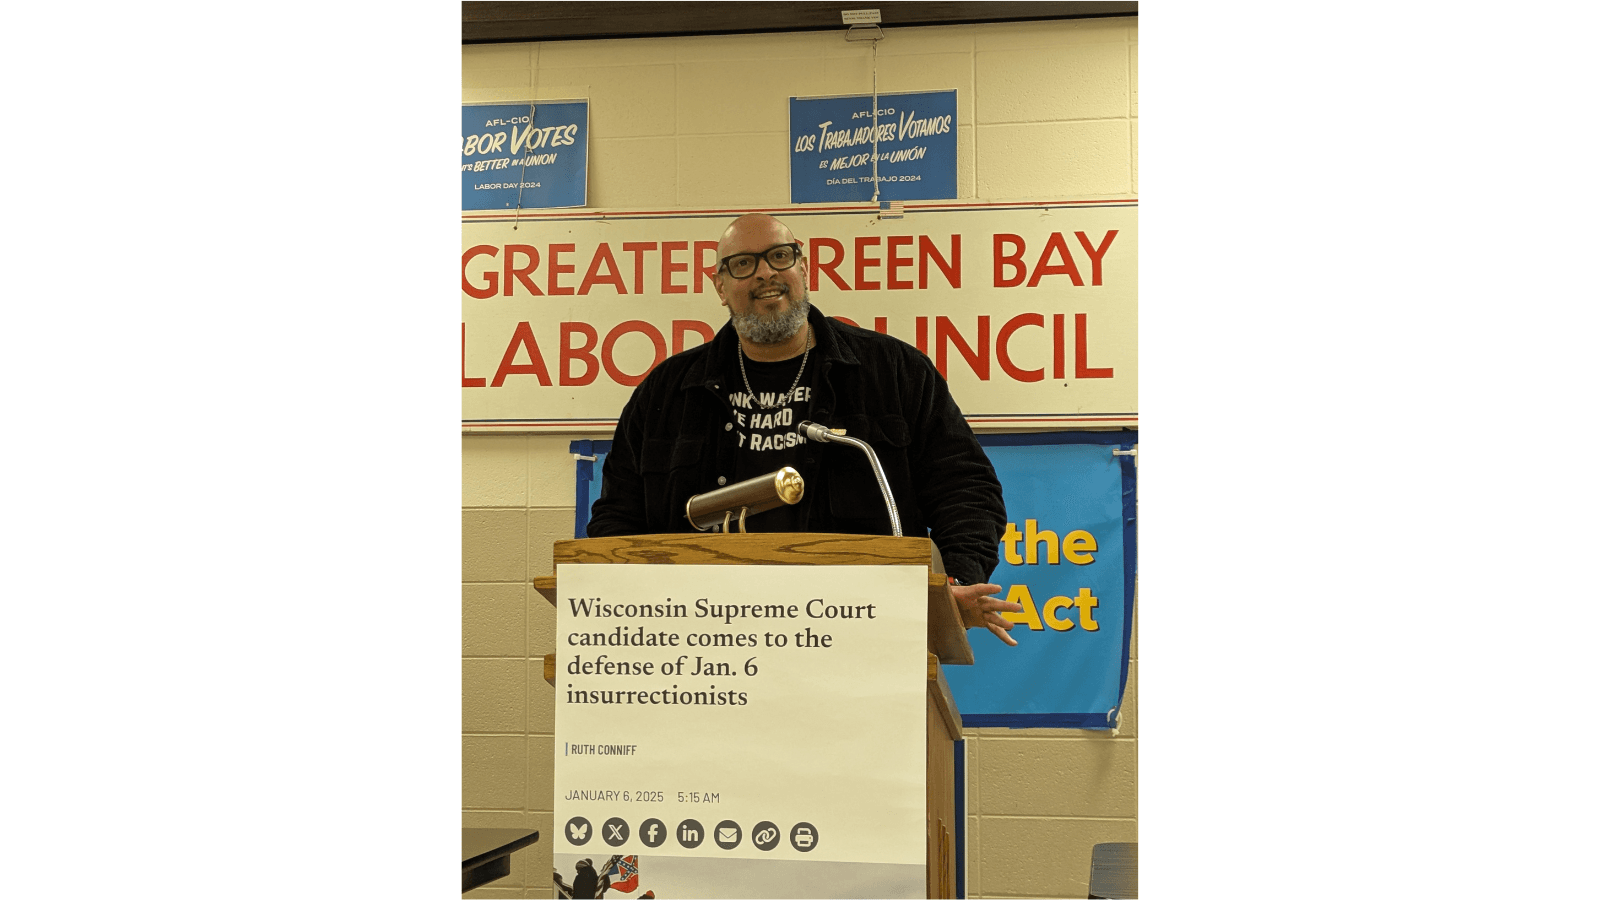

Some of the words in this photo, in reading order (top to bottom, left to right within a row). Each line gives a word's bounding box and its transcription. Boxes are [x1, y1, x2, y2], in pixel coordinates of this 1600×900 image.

[485, 116, 530, 127] AFL-CIO
[795, 134, 816, 152] LOS
[818, 121, 896, 153] TRABAJADORES
[899, 110, 952, 142] VOTAMOS
[461, 132, 507, 156] BOR
[510, 124, 578, 155] VOTES
[474, 158, 510, 172] BETTER
[526, 153, 557, 166] UNION
[819, 160, 828, 168] ES
[830, 153, 870, 170] MEJOR
[880, 152, 890, 161] LA
[890, 146, 927, 163] UNIÓN
[794, 234, 962, 292] REEN
[993, 230, 1120, 288] BAY
[750, 408, 793, 429] HARD
[1000, 518, 1098, 566] the
[568, 597, 688, 618] Wisconsin
[694, 598, 799, 624] Supreme
[805, 598, 876, 620] Court
[1000, 584, 1100, 632] Act
[567, 626, 680, 647] candidate
[686, 632, 758, 647] comes
[764, 632, 788, 648] to
[794, 628, 833, 648] the
[567, 655, 654, 676] defense
[660, 655, 688, 676] of
[690, 656, 737, 677] Jan.
[744, 656, 759, 677] 6
[567, 683, 748, 706] insurrectionists
[571, 744, 595, 755] RUTH
[598, 744, 637, 756] CONNIFF
[565, 790, 620, 801] JANUARY
[623, 791, 632, 803] 6,
[636, 791, 664, 802] 2025
[677, 792, 700, 803] 5:15
[702, 792, 720, 803] AM
